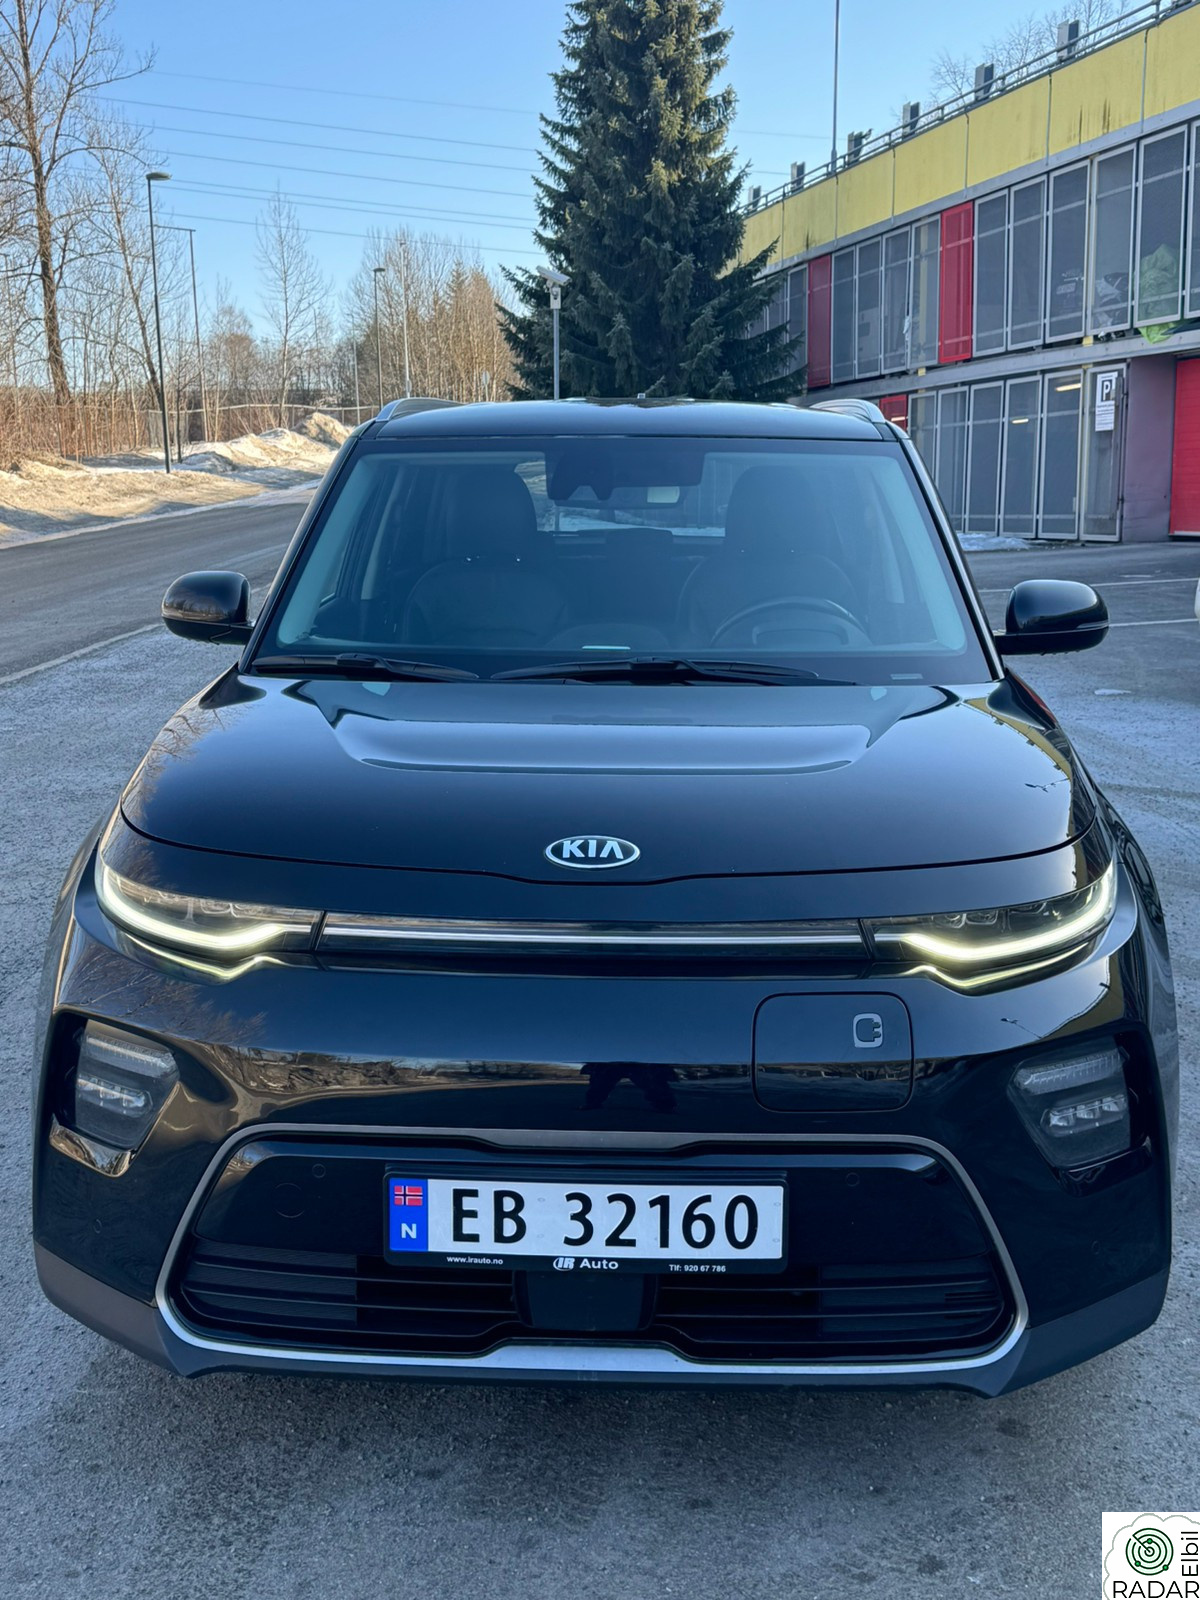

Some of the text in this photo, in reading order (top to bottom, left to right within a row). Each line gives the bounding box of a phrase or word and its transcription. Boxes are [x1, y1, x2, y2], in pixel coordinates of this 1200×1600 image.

[1103, 381, 1111, 400] P
[562, 839, 624, 859] KIA
[452, 1188, 759, 1250] EB 32160
[401, 1223, 417, 1239] N
[446, 1256, 504, 1265] www.irauto.no
[579, 1258, 619, 1270] Auto
[684, 1264, 699, 1272] 920
[700, 1264, 710, 1272] 67
[711, 1265, 726, 1273] 786
